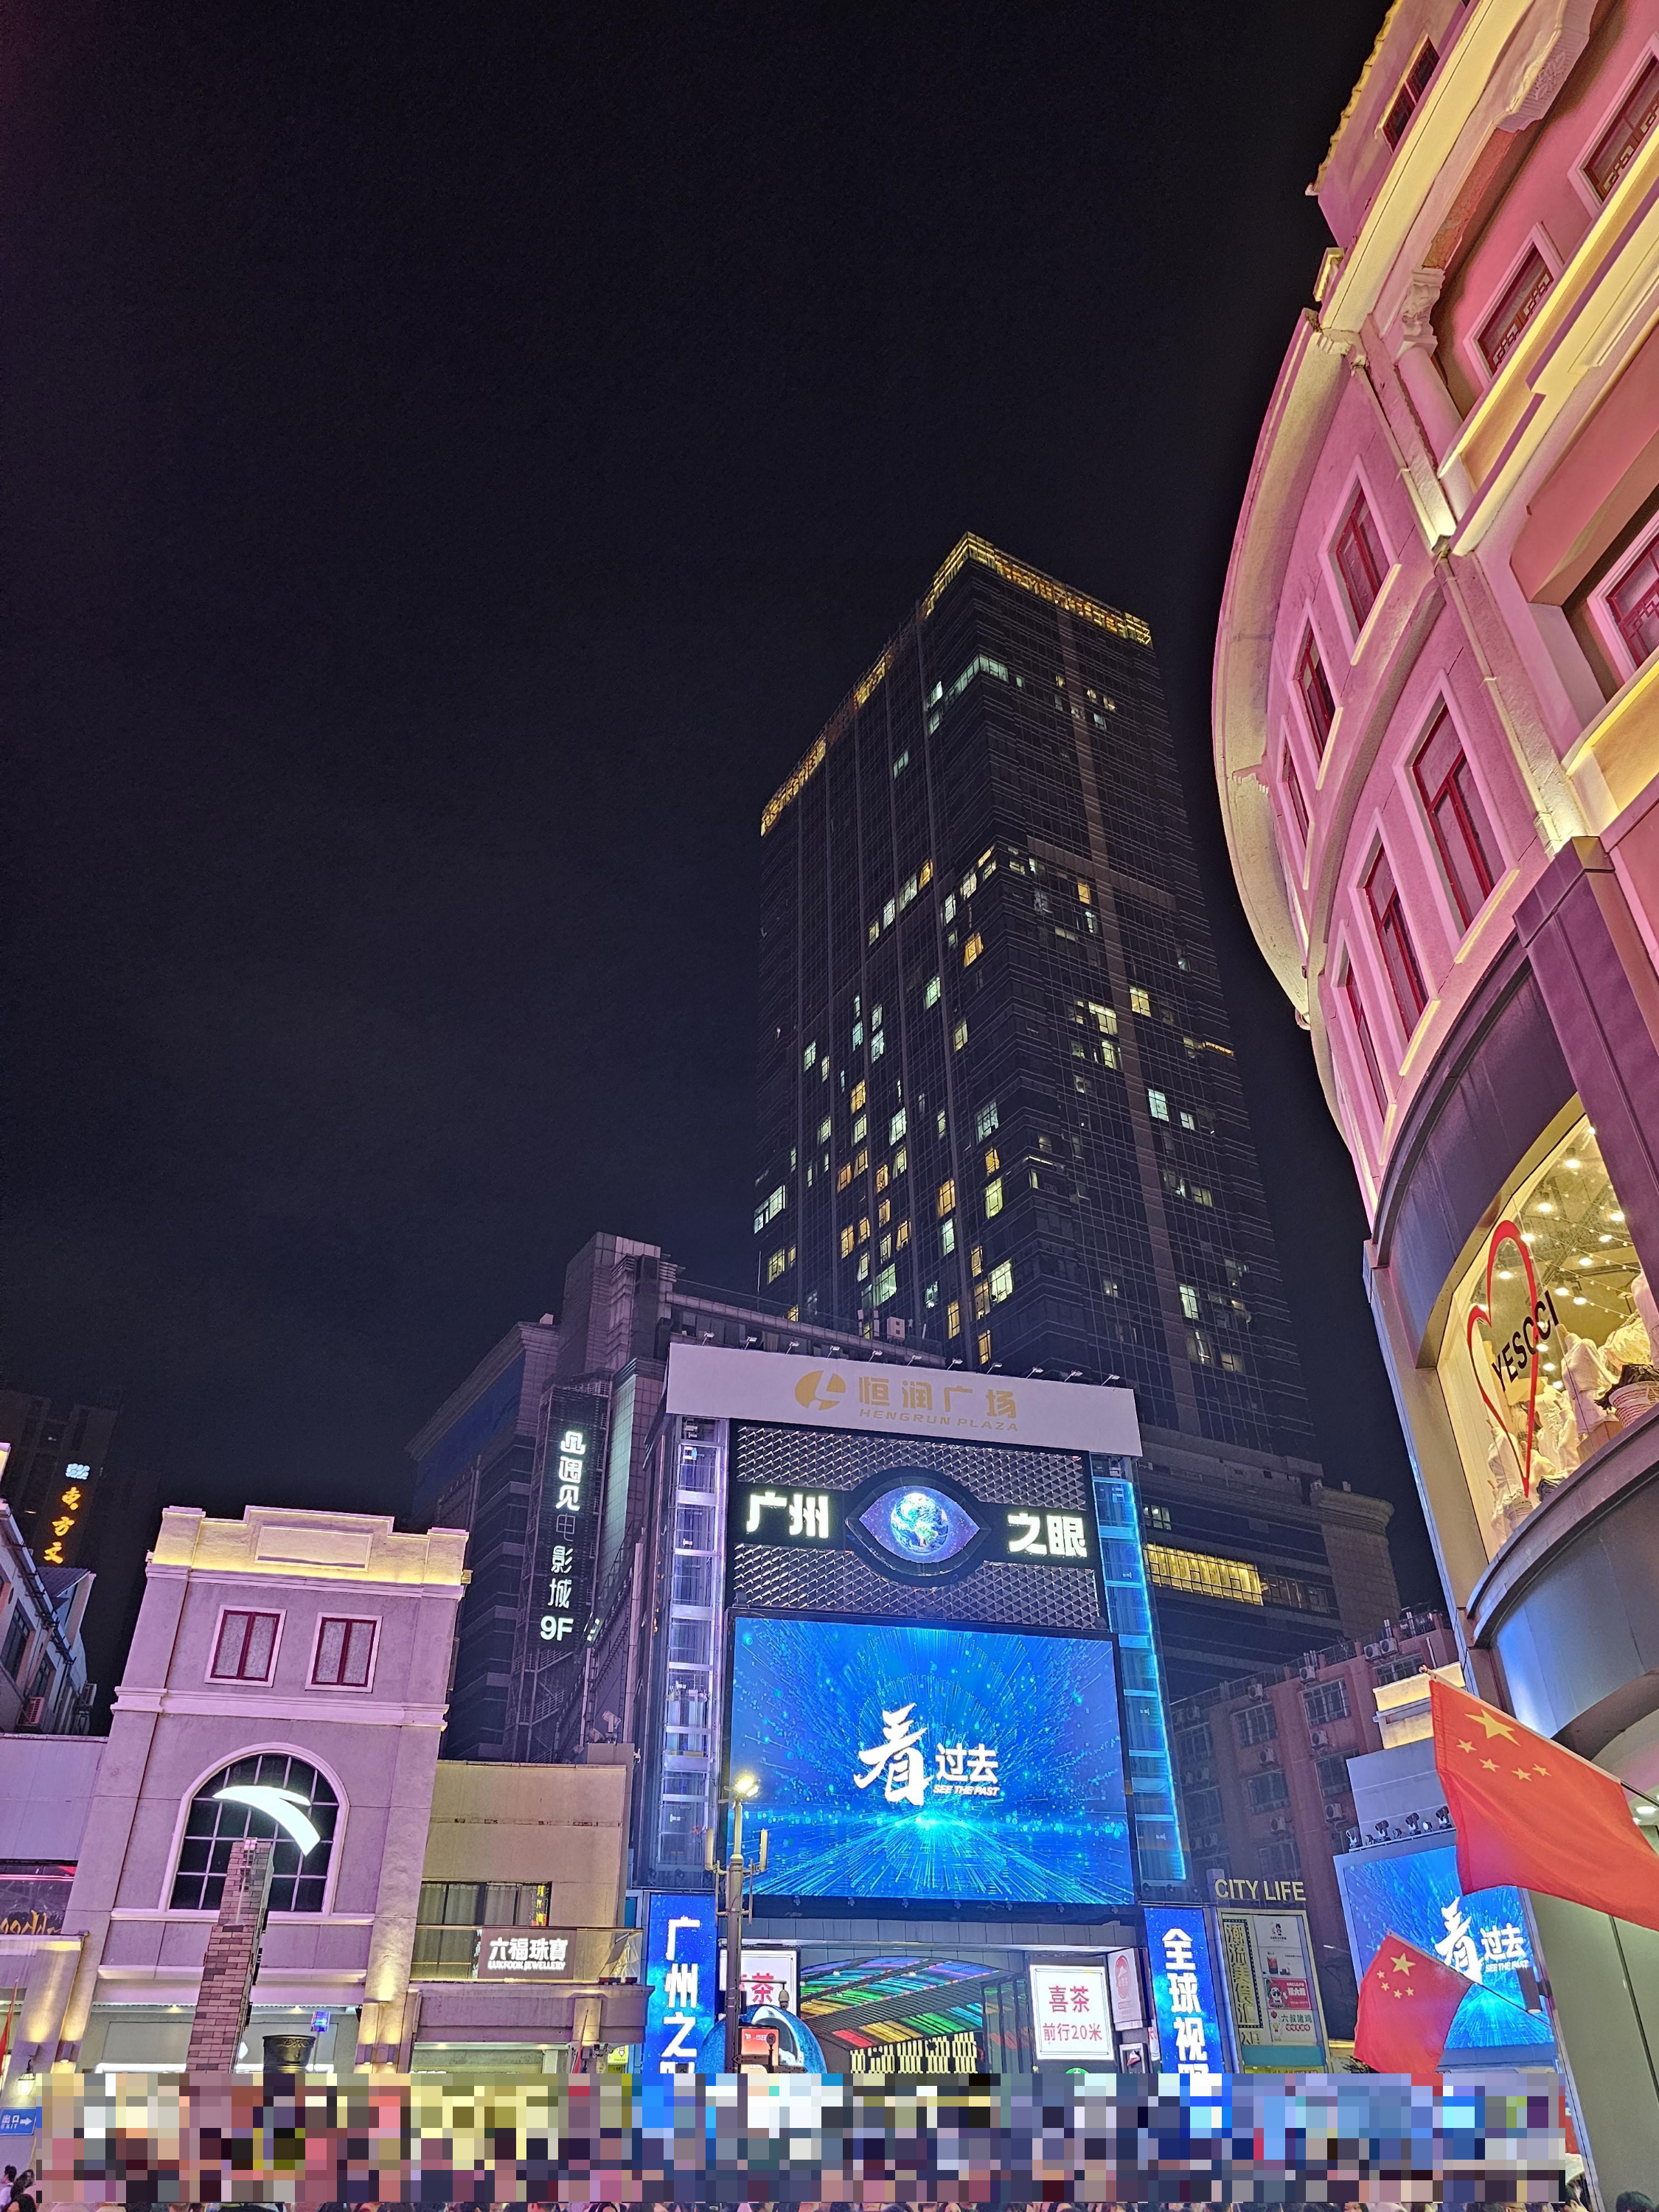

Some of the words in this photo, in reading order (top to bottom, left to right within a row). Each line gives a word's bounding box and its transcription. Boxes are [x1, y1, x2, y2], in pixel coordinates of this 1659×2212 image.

[1491, 1290, 1559, 1392] YESCCI
[858, 1376, 1017, 1419] 恒润广场
[859, 1408, 950, 1425] HENGRUN
[956, 1417, 1018, 1432] PLAZA
[745, 1492, 830, 1538] 广州
[1006, 1513, 1088, 1557] 之眼
[540, 1615, 574, 1641] 9F
[933, 1784, 953, 1794] SEE
[953, 1785, 974, 1795] THE
[973, 1786, 1000, 1797] PAST
[1214, 1879, 1258, 1899] CITY
[1264, 1881, 1306, 1901] LIFE
[490, 1937, 568, 1961] 六福珠寶
[660, 1916, 700, 2073] 广州之
[1048, 1986, 1090, 2013] 喜茶
[1162, 1928, 1209, 2073] 全球视
[1043, 2023, 1102, 2042] 前行20米
